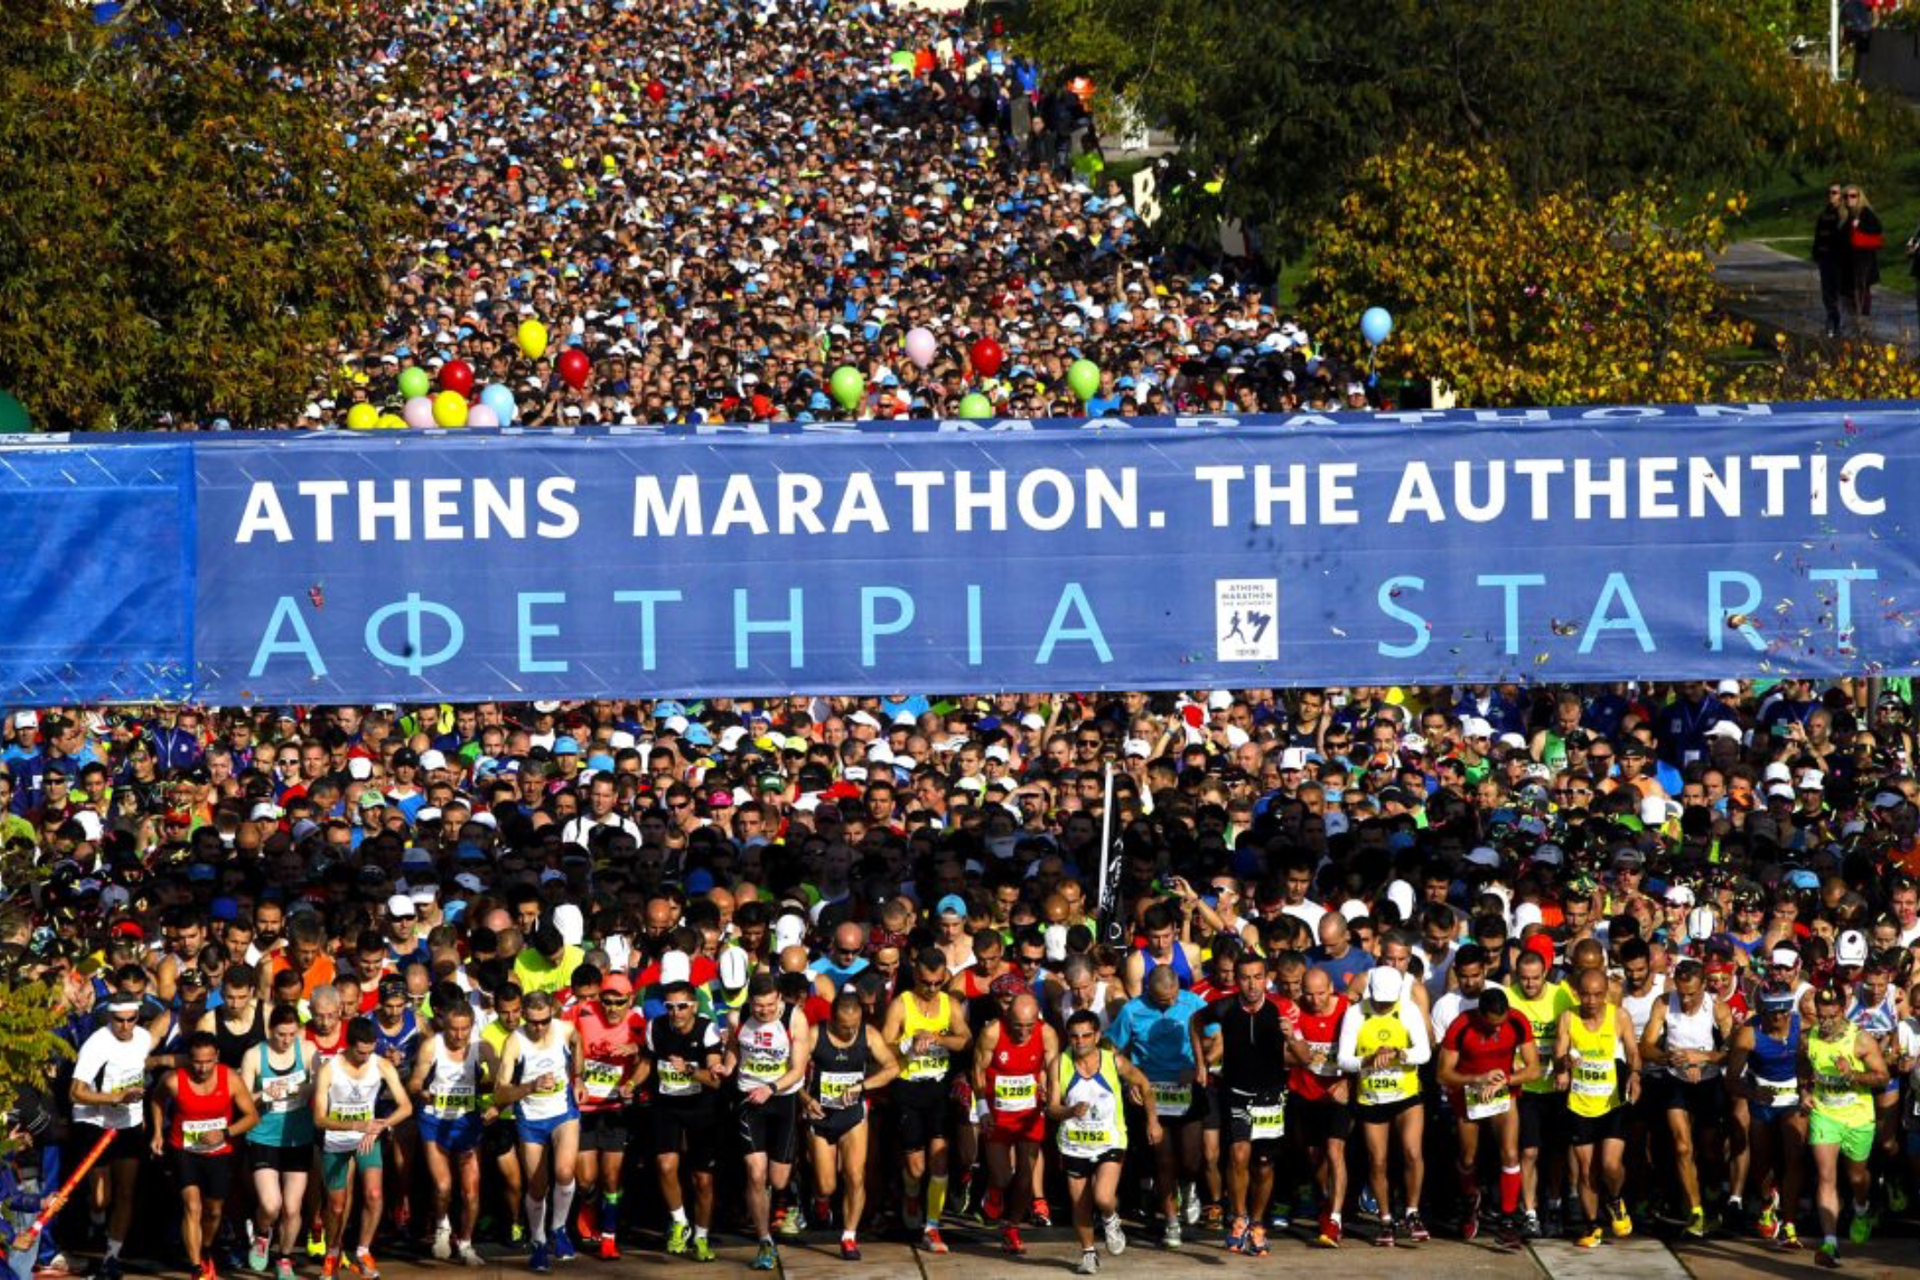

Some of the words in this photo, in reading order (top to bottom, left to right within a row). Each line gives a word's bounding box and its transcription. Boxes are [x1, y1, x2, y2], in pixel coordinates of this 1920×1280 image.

[235, 476, 580, 543] ATHENS
[633, 467, 1165, 537] MARATHON.
[1195, 463, 1359, 527] THE
[1388, 453, 1886, 523] AUTHENTIC
[1377, 562, 1878, 658] START
